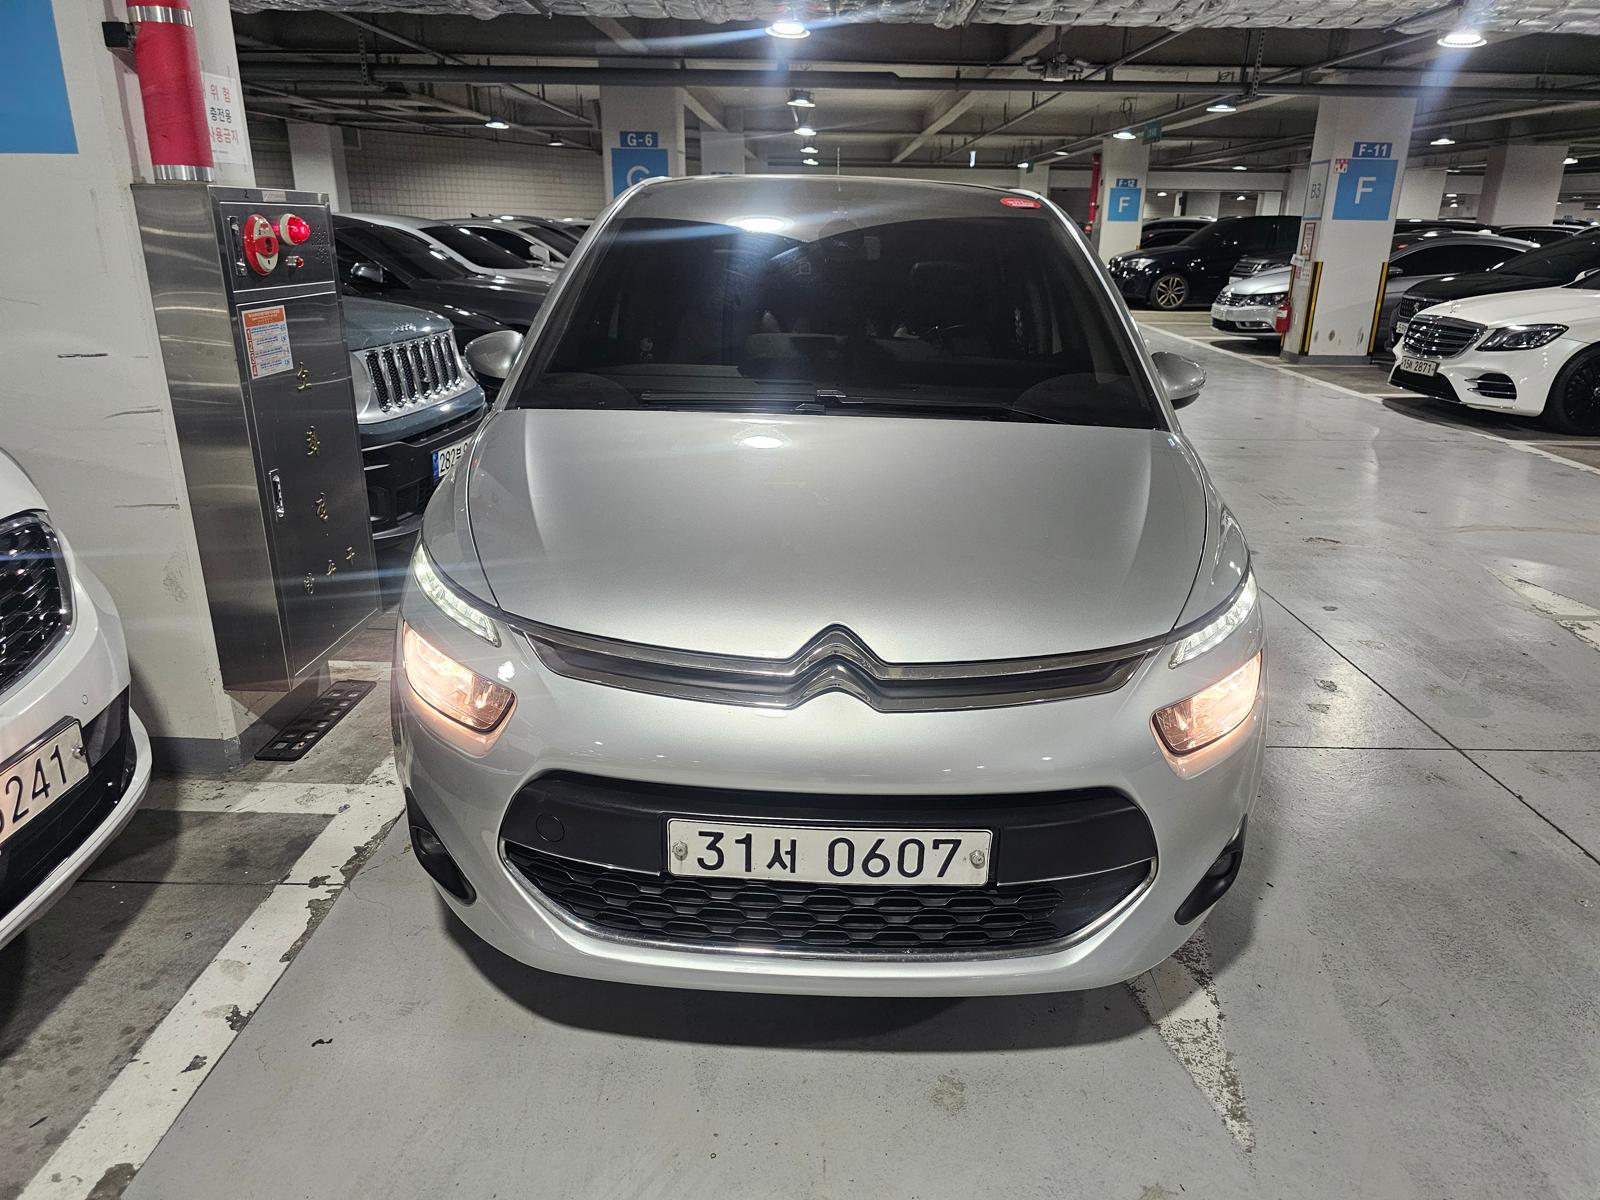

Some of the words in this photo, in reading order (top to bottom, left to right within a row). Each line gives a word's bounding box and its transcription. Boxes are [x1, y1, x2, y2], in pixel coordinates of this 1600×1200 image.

[209, 107, 232, 123] 충전용
[626, 132, 653, 147] G-6
[1358, 143, 1388, 157] F-11
[1310, 182, 1322, 199] B3
[1354, 176, 1377, 205] F
[1118, 196, 1131, 213] F
[1413, 360, 1432, 374] 2871
[696, 830, 797, 874] 31서
[827, 836, 963, 879] 0607
